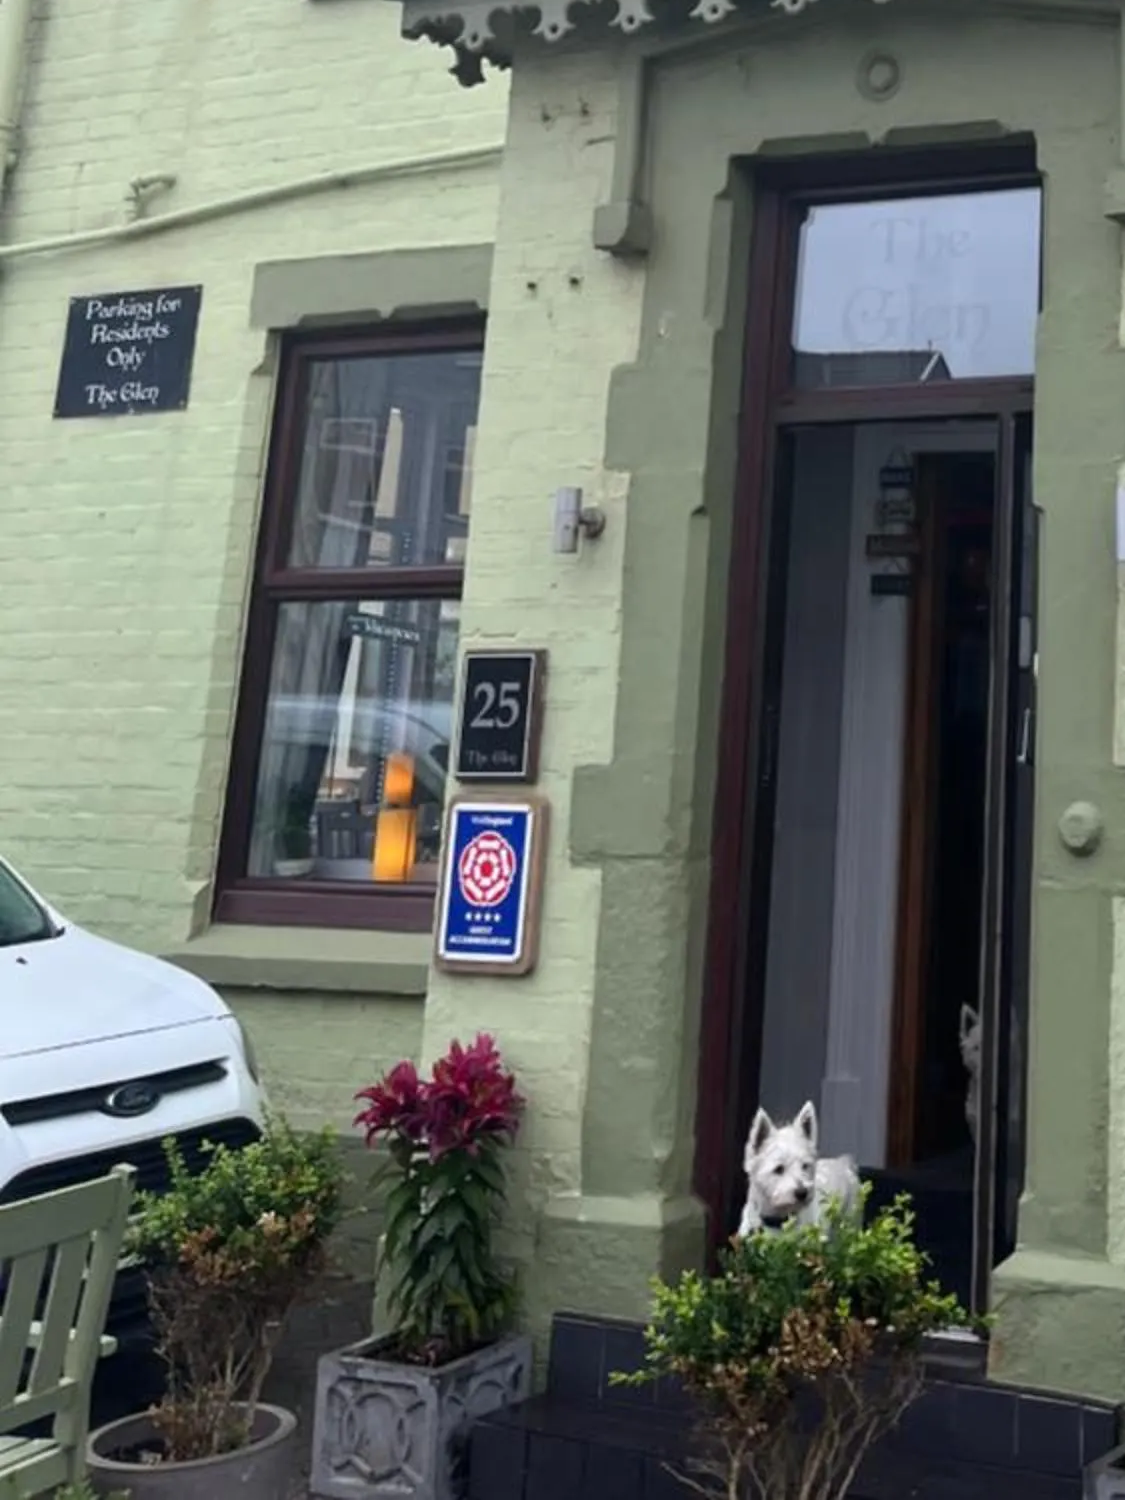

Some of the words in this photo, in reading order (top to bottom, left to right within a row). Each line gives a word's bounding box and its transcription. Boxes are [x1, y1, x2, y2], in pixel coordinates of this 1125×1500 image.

[85, 298, 154, 321] Parking
[155, 294, 181, 314] for
[90, 321, 171, 345] Residents
[105, 346, 146, 372] Only
[84, 383, 118, 409] The
[469, 681, 521, 728] 25
